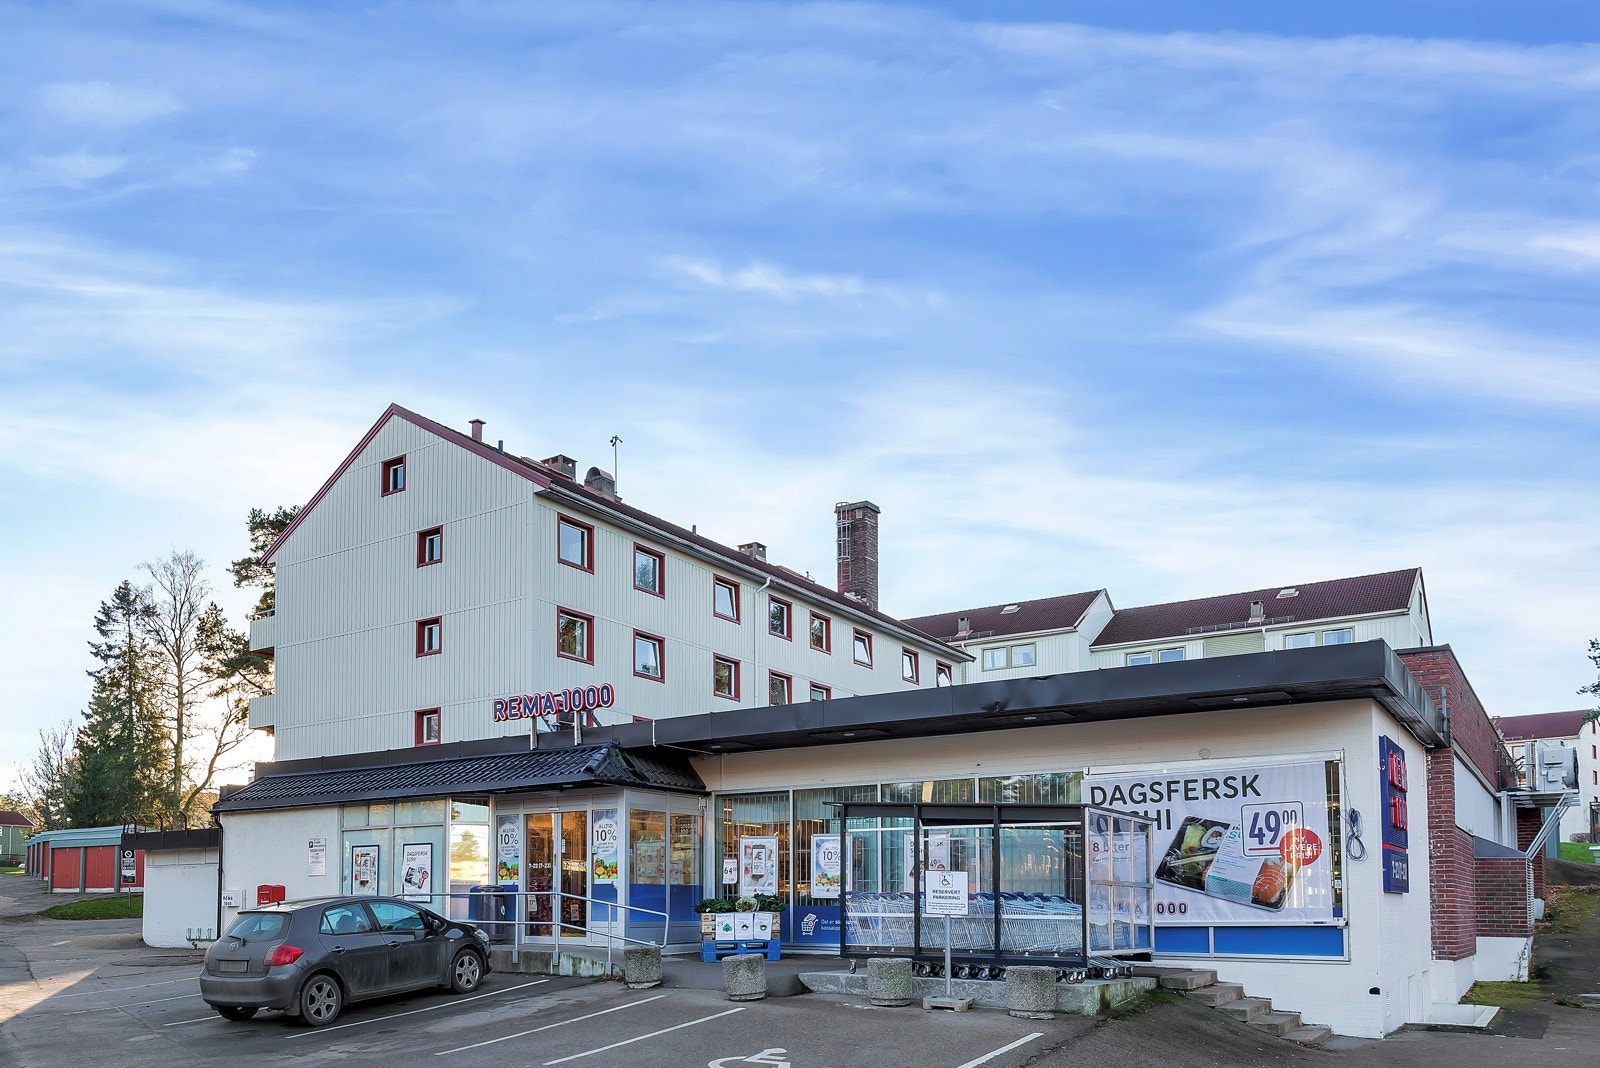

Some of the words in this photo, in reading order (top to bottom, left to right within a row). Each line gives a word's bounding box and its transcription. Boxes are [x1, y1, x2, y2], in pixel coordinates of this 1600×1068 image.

[493, 691, 558, 722] REMA
[561, 683, 614, 713] 1000
[1090, 774, 1262, 806] DAGSFERSK
[500, 833, 519, 845] 10%
[595, 829, 617, 841] 10%
[1092, 842, 1100, 852] 8
[1103, 841, 1129, 852] bter
[823, 851, 841, 861] 10%
[1156, 902, 1188, 915] 000
